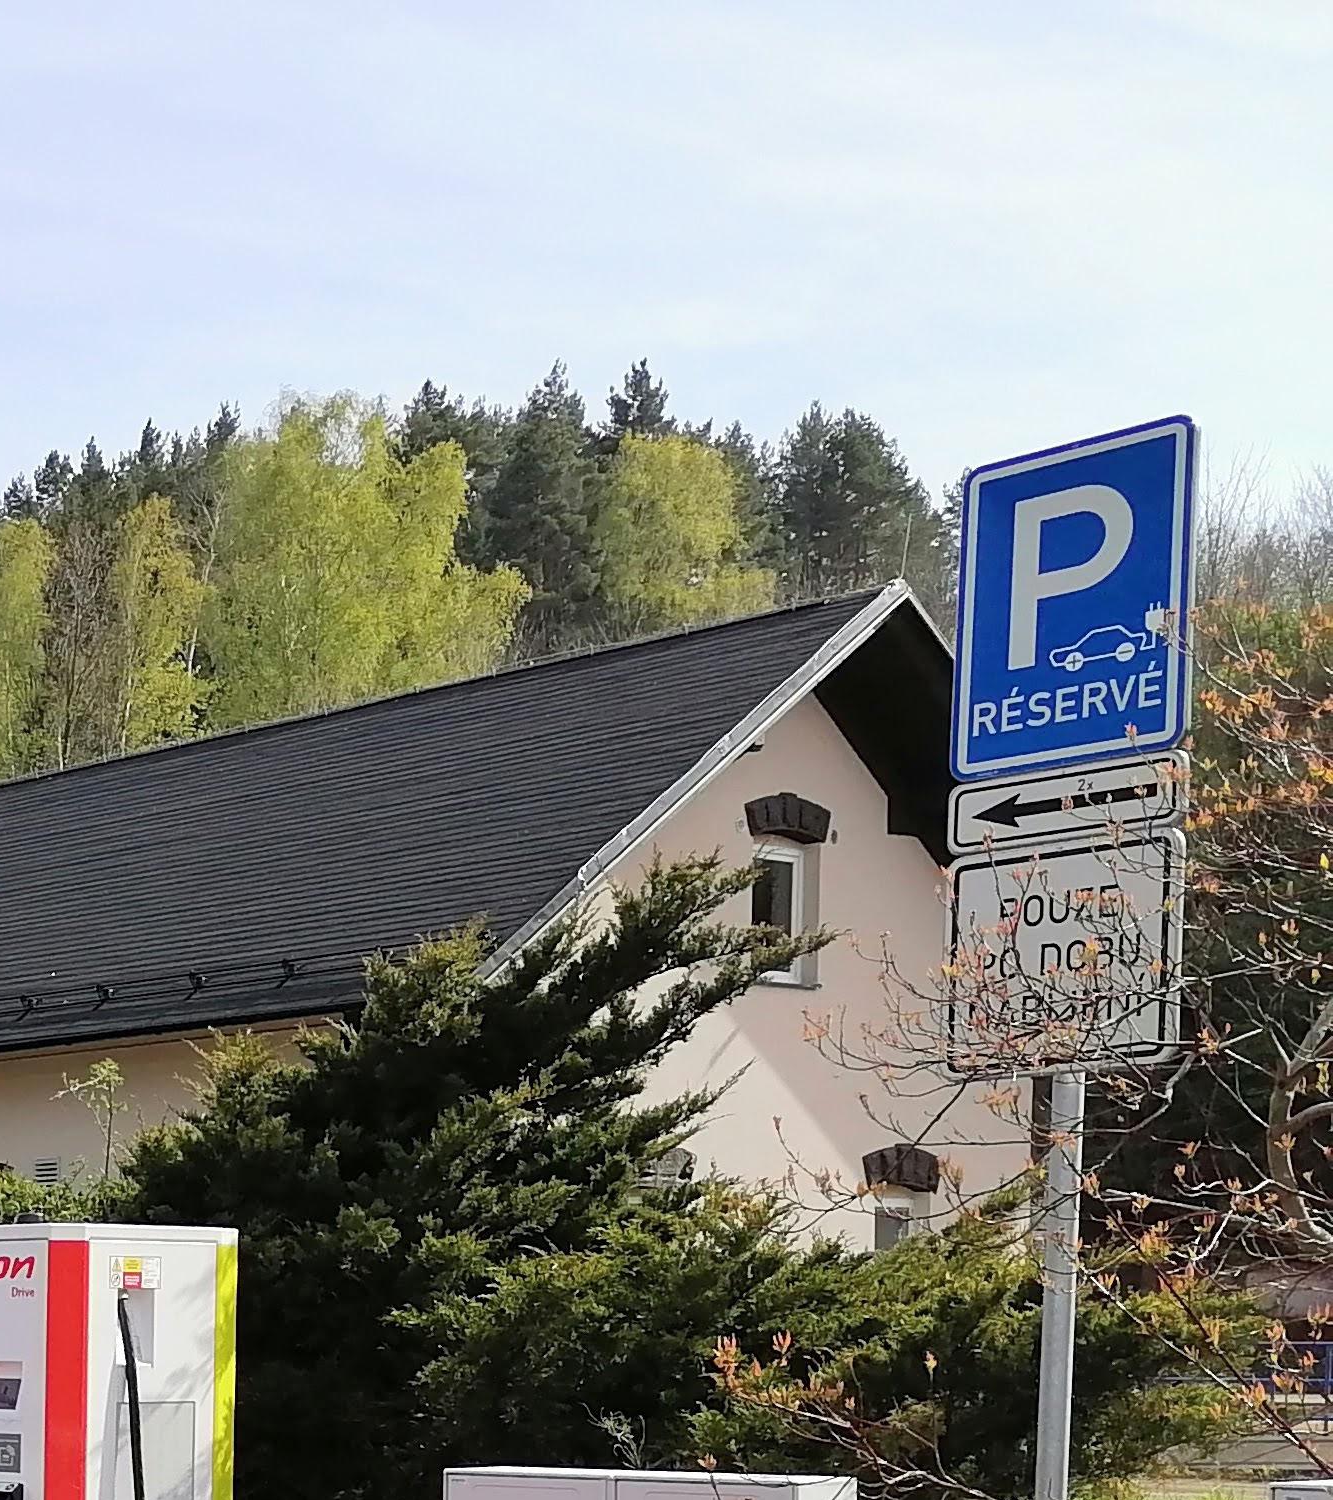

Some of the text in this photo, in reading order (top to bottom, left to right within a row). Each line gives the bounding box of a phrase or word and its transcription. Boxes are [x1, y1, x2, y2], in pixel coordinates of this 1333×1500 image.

[1008, 484, 1134, 671] P
[972, 660, 1163, 737] RÉSERVÉ
[1078, 779, 1093, 791] 2x
[12, 1287, 34, 1297] Drive
